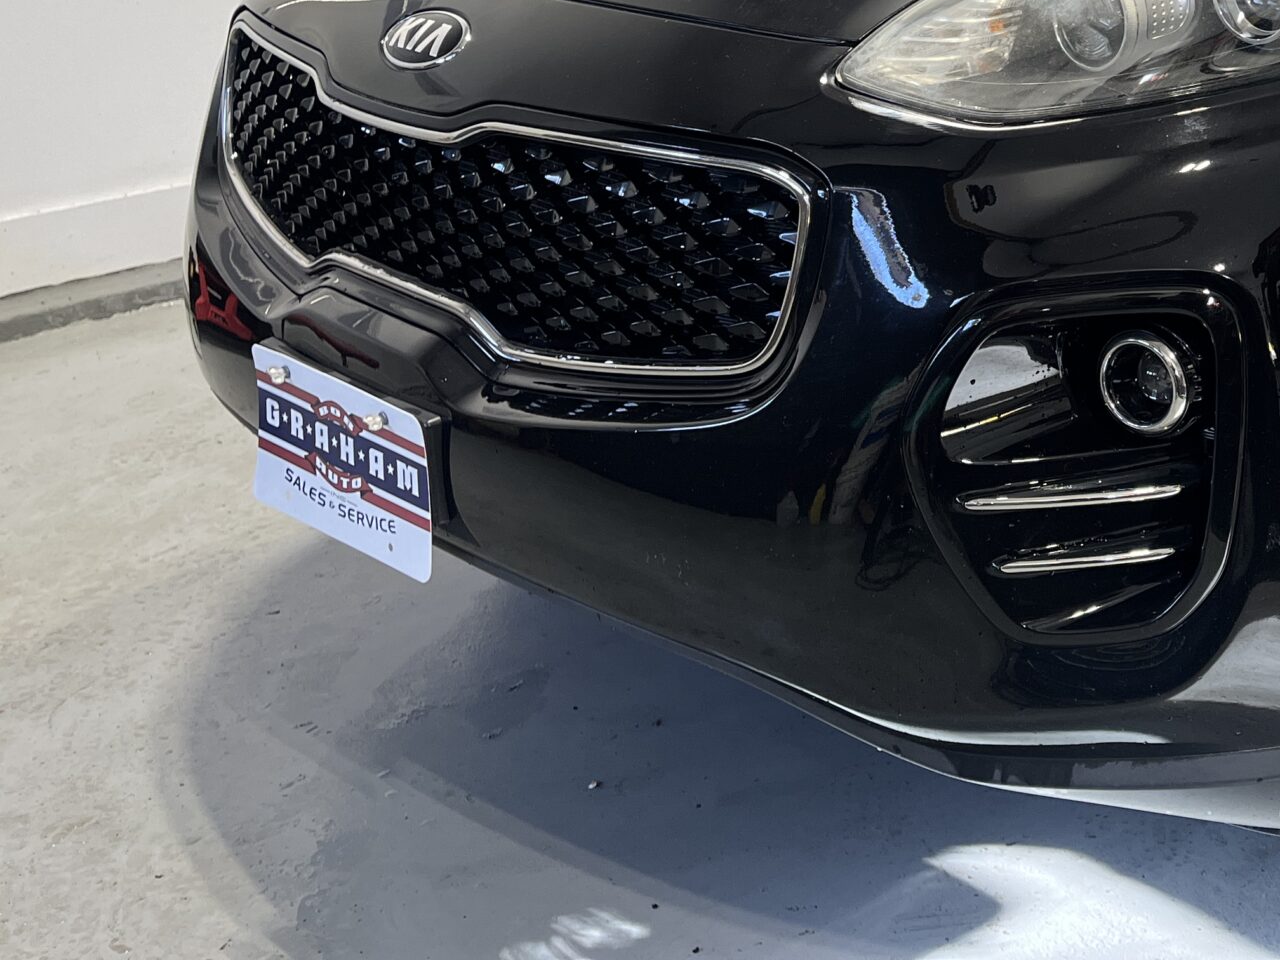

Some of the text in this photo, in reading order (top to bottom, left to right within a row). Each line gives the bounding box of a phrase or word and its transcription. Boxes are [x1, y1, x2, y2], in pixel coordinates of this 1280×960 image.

[388, 16, 453, 58] KIA
[315, 455, 363, 490] AUTO
[283, 467, 327, 508] SALES
[338, 502, 397, 535] SERVICE
